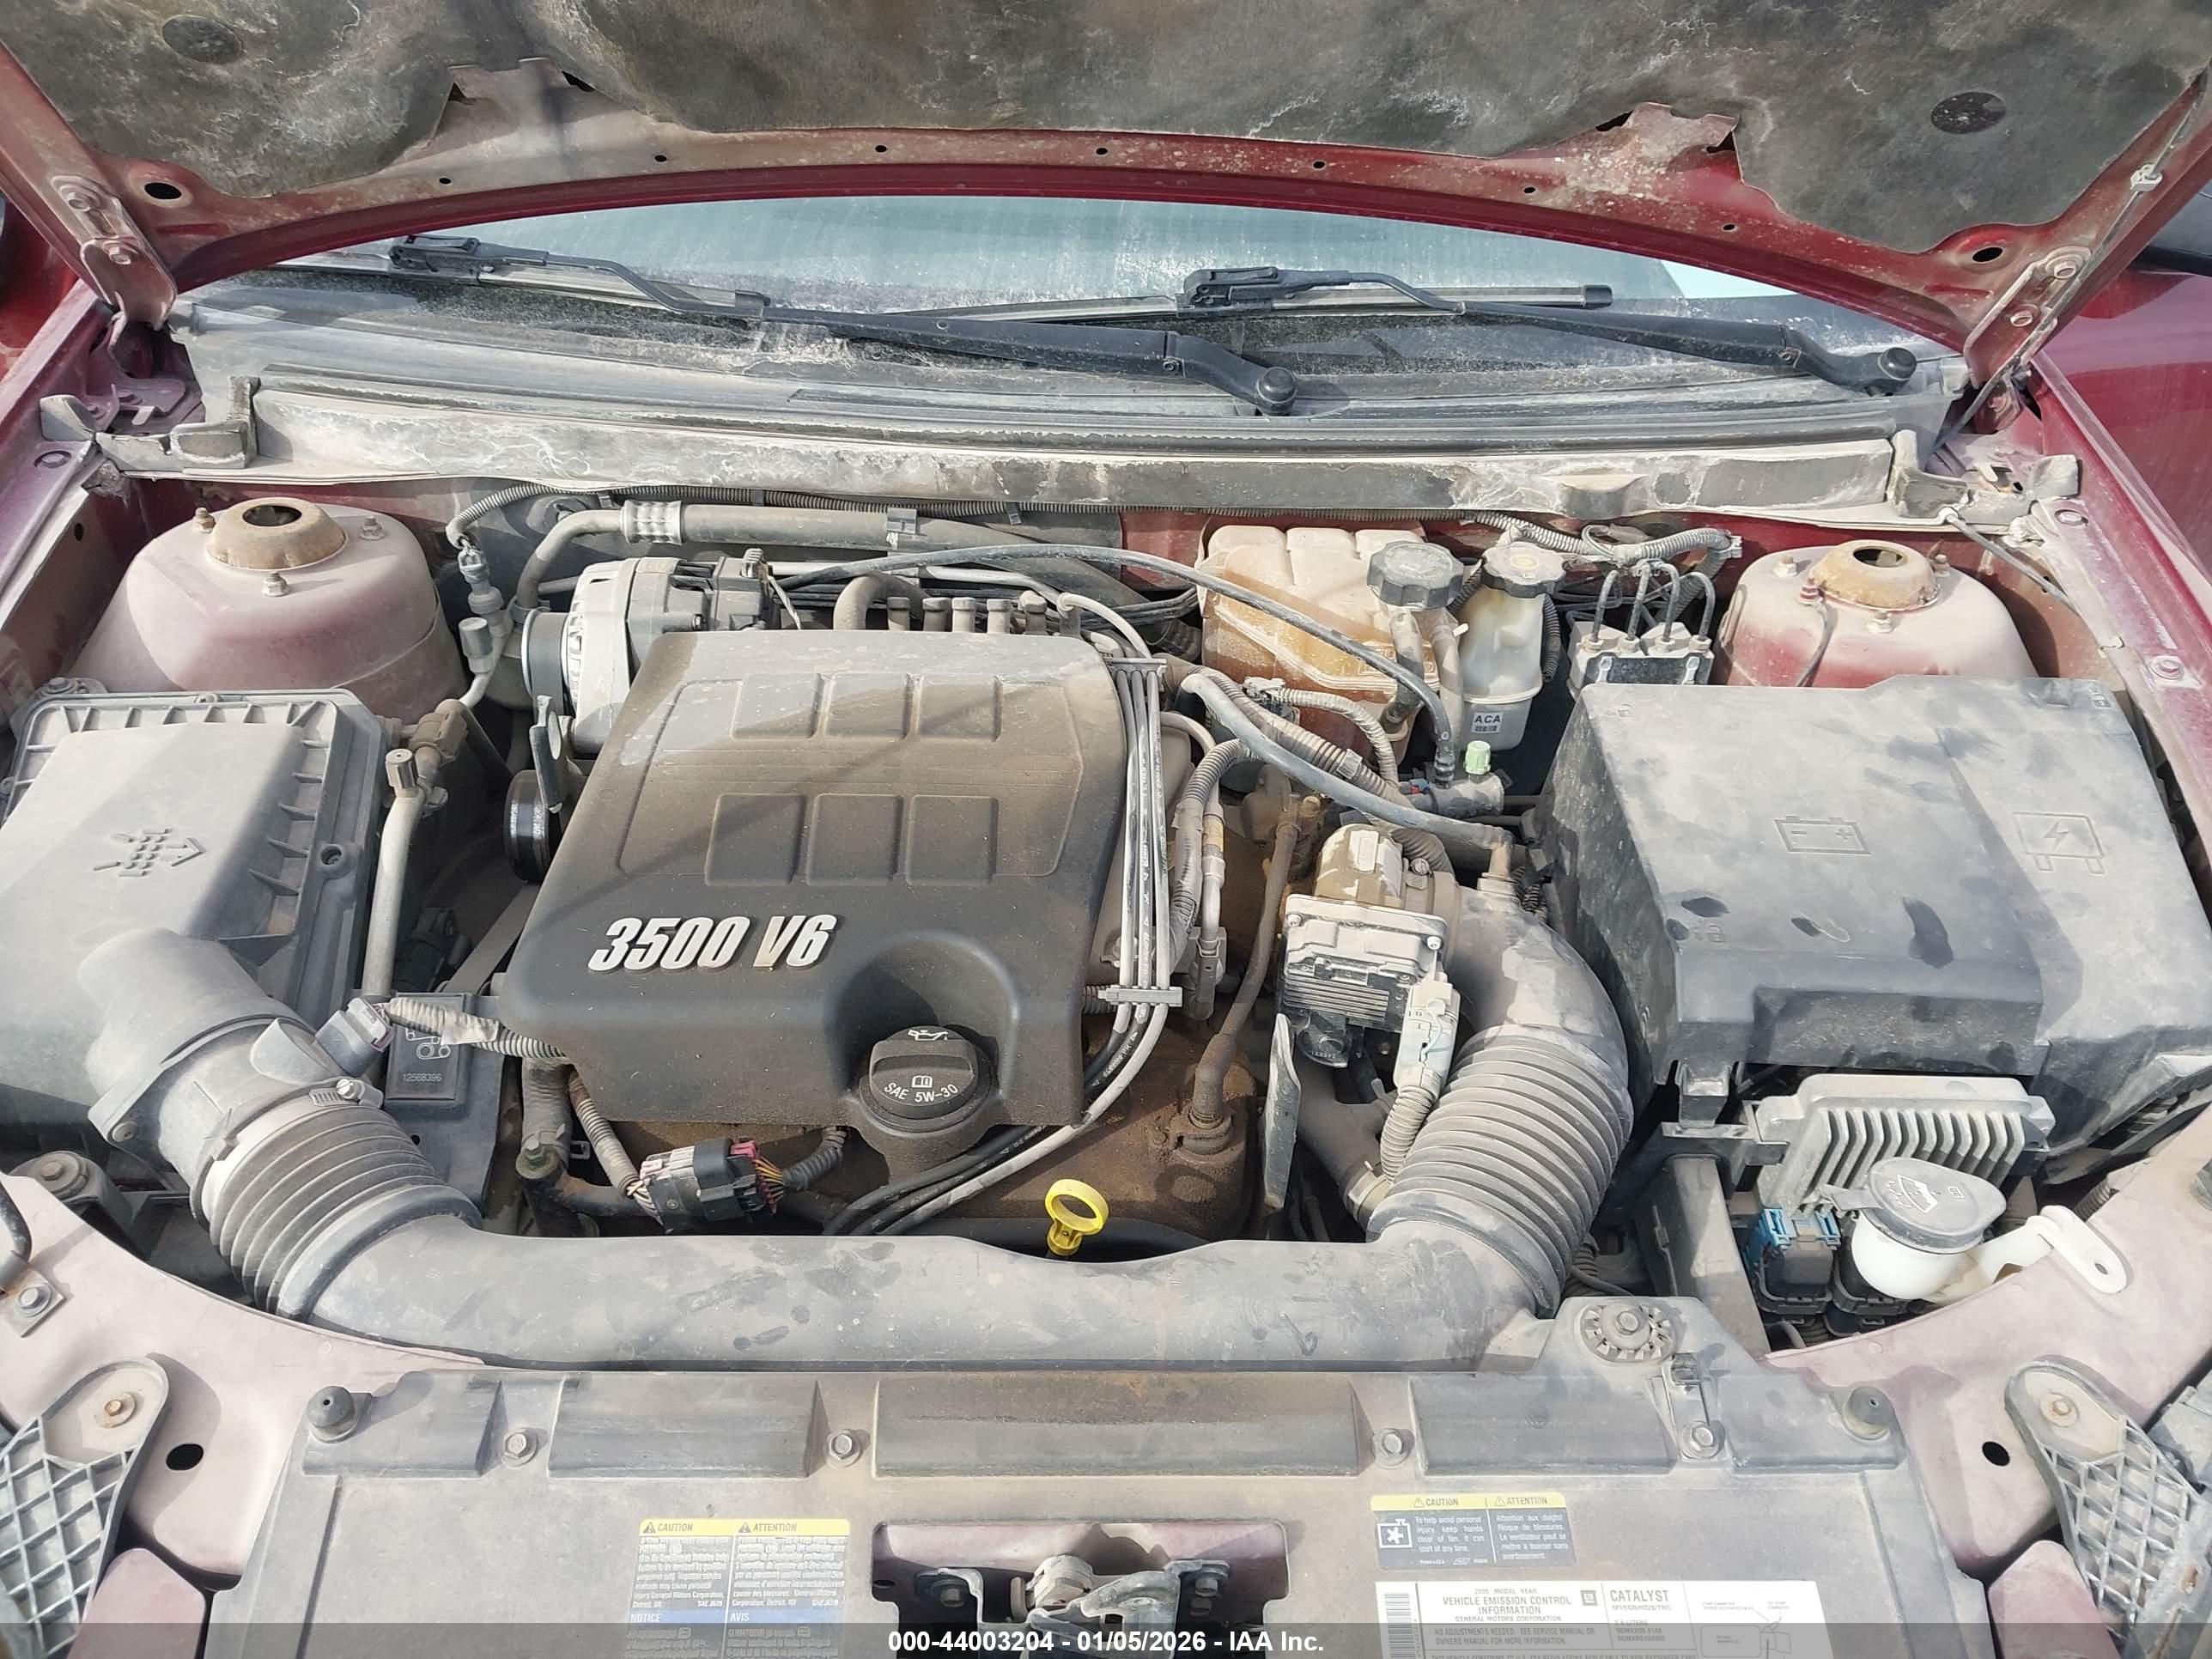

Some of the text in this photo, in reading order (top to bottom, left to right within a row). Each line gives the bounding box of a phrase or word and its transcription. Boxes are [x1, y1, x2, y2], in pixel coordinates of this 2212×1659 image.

[1474, 714, 1500, 723] ACA
[587, 914, 838, 972] 3500 V6
[884, 1082, 958, 1103] SAE 5W-30
[1425, 1498, 1458, 1506] CAUTION
[1610, 1589, 1669, 1601] CATALYST
[1443, 1596, 1480, 1605] VEHICLE
[1484, 1596, 1527, 1605] EMISSION
[1530, 1596, 1571, 1605] CONTROL
[1479, 1606, 1541, 1614] INFORMATION
[730, 1613, 750, 1621] AVIS
